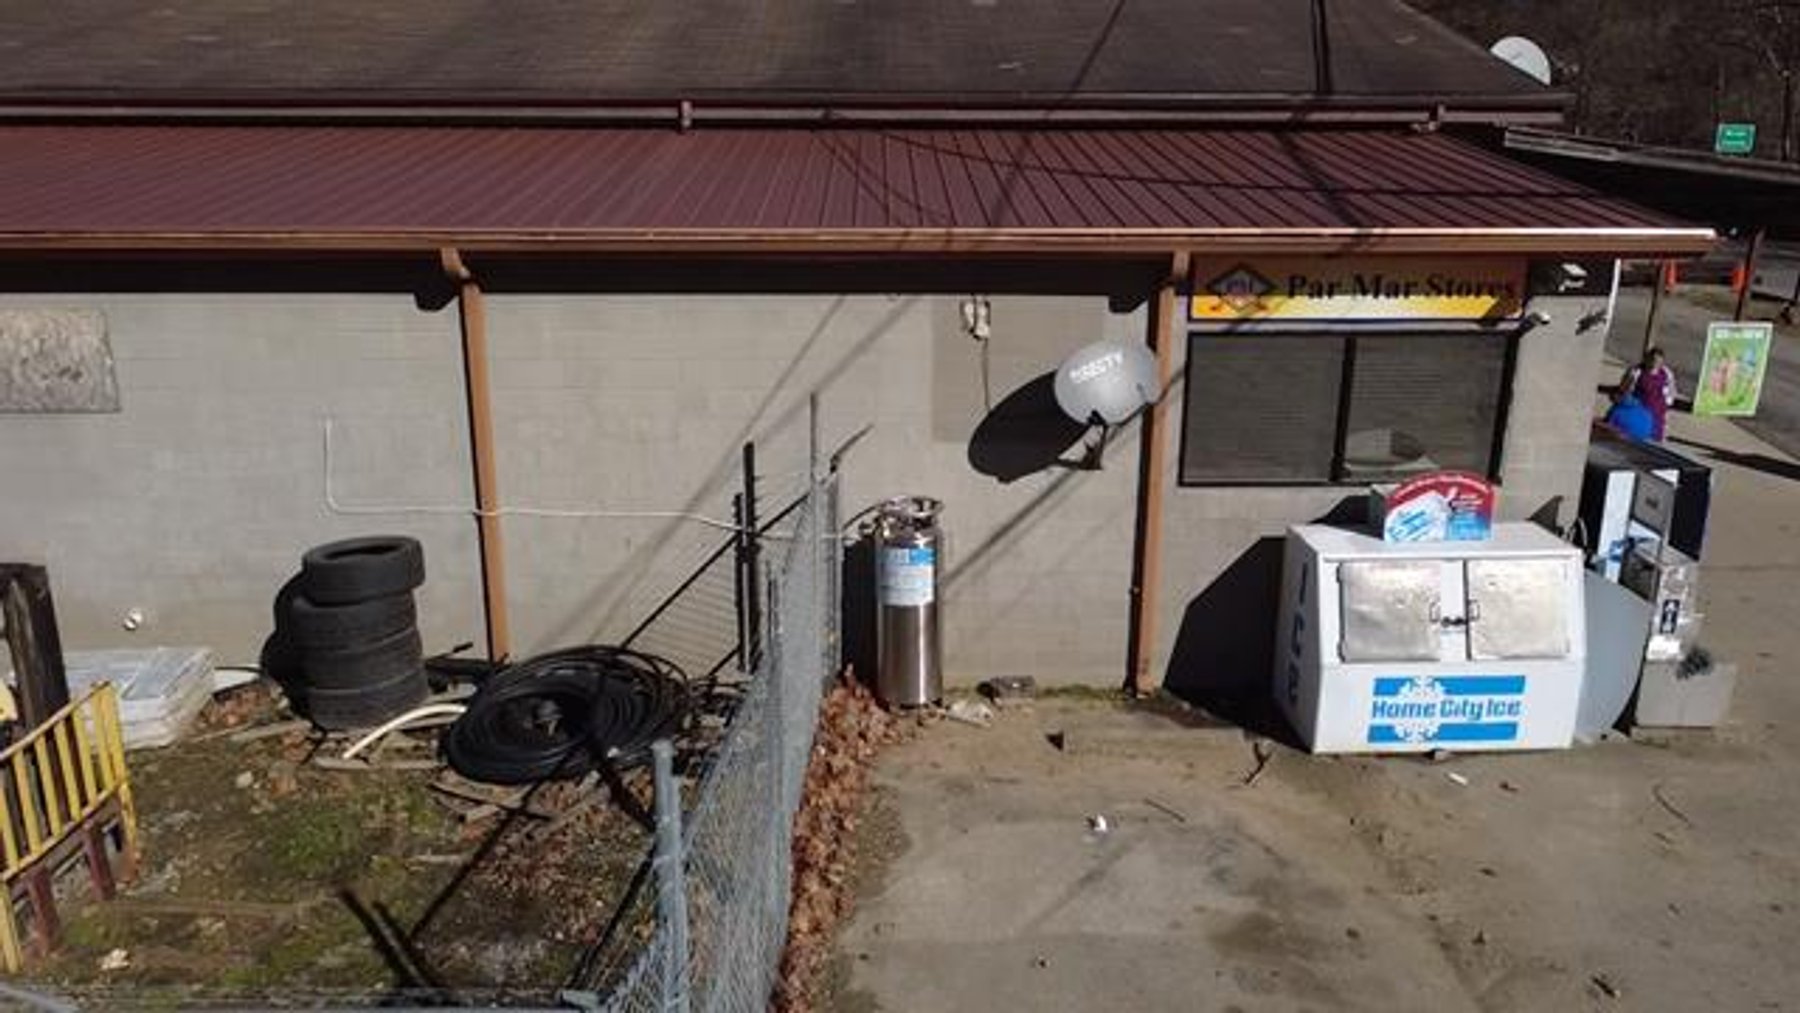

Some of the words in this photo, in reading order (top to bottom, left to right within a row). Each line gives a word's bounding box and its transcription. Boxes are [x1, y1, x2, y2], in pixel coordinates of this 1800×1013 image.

[1287, 273, 1338, 298] Par
[1353, 273, 1419, 299] Mar
[1425, 272, 1516, 299] Stores
[1372, 700, 1437, 718] Home
[1439, 699, 1484, 721] City
[1486, 699, 1521, 717] Ice
